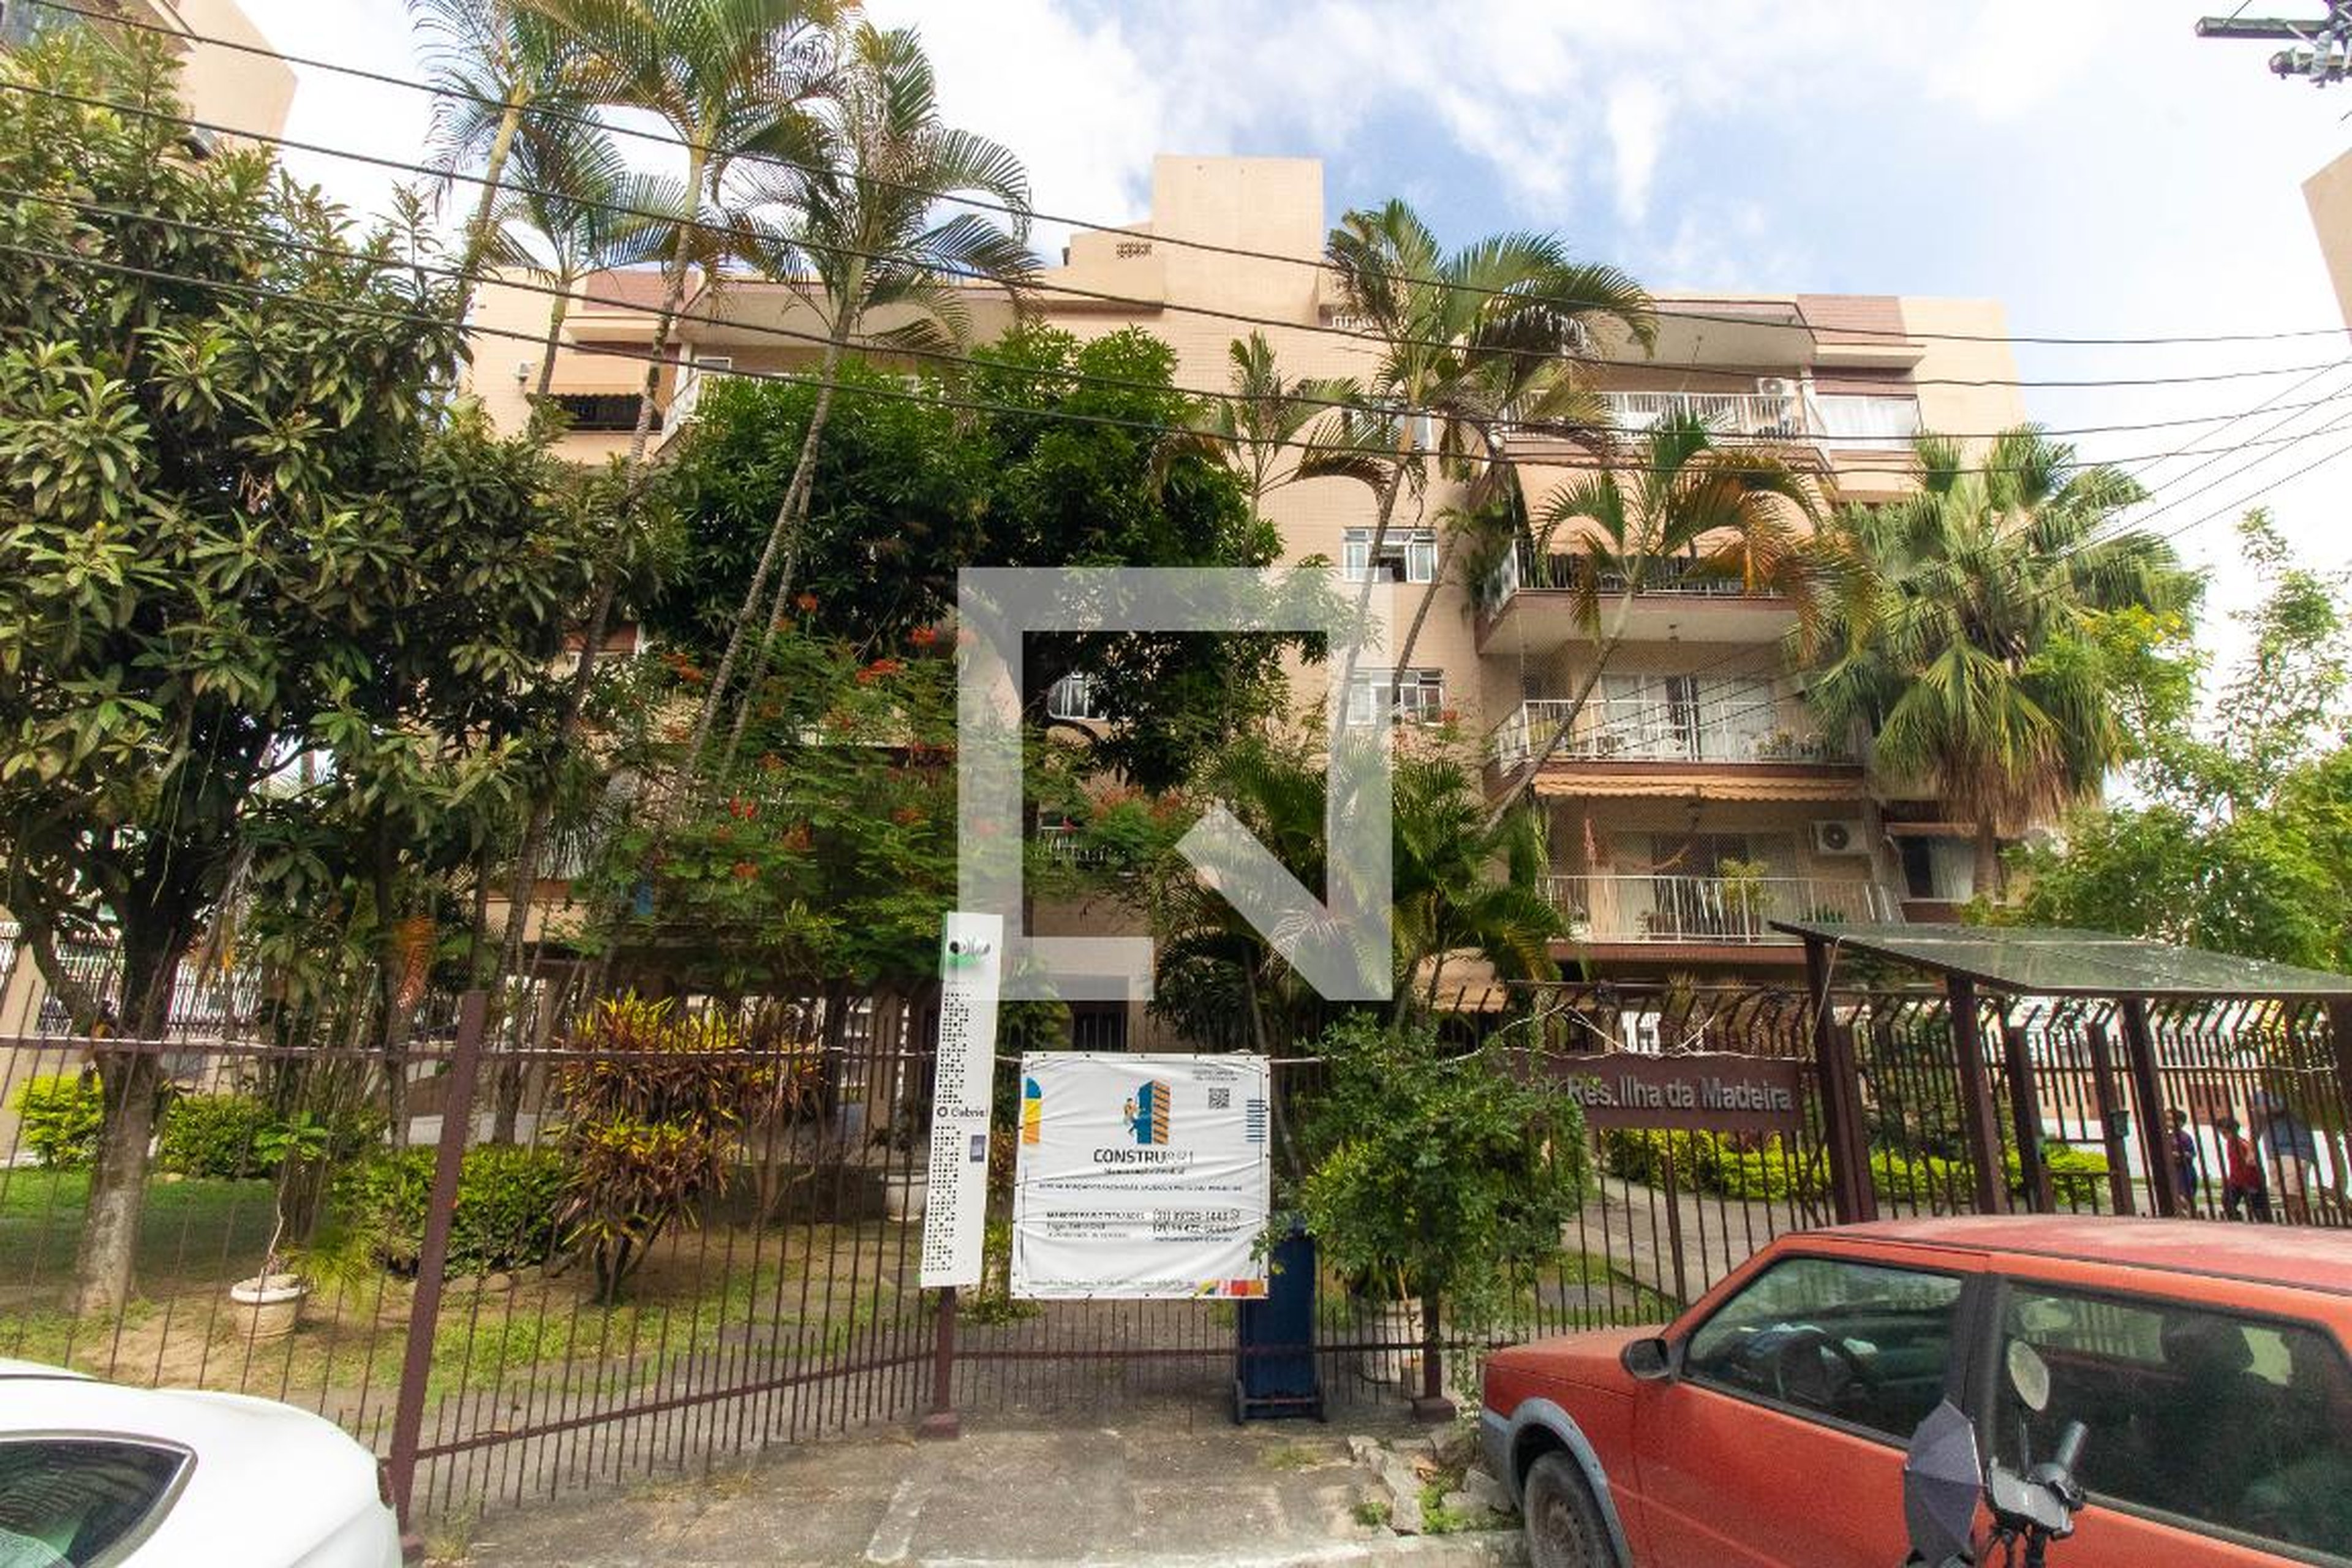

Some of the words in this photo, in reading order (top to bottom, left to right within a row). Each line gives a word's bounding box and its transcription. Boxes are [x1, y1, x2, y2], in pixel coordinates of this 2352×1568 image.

[1568, 1075, 1618, 1106] Res.
[1619, 1076, 1663, 1107] Ilha
[1666, 1077, 1695, 1107] da
[1700, 1077, 1793, 1110] Madeira
